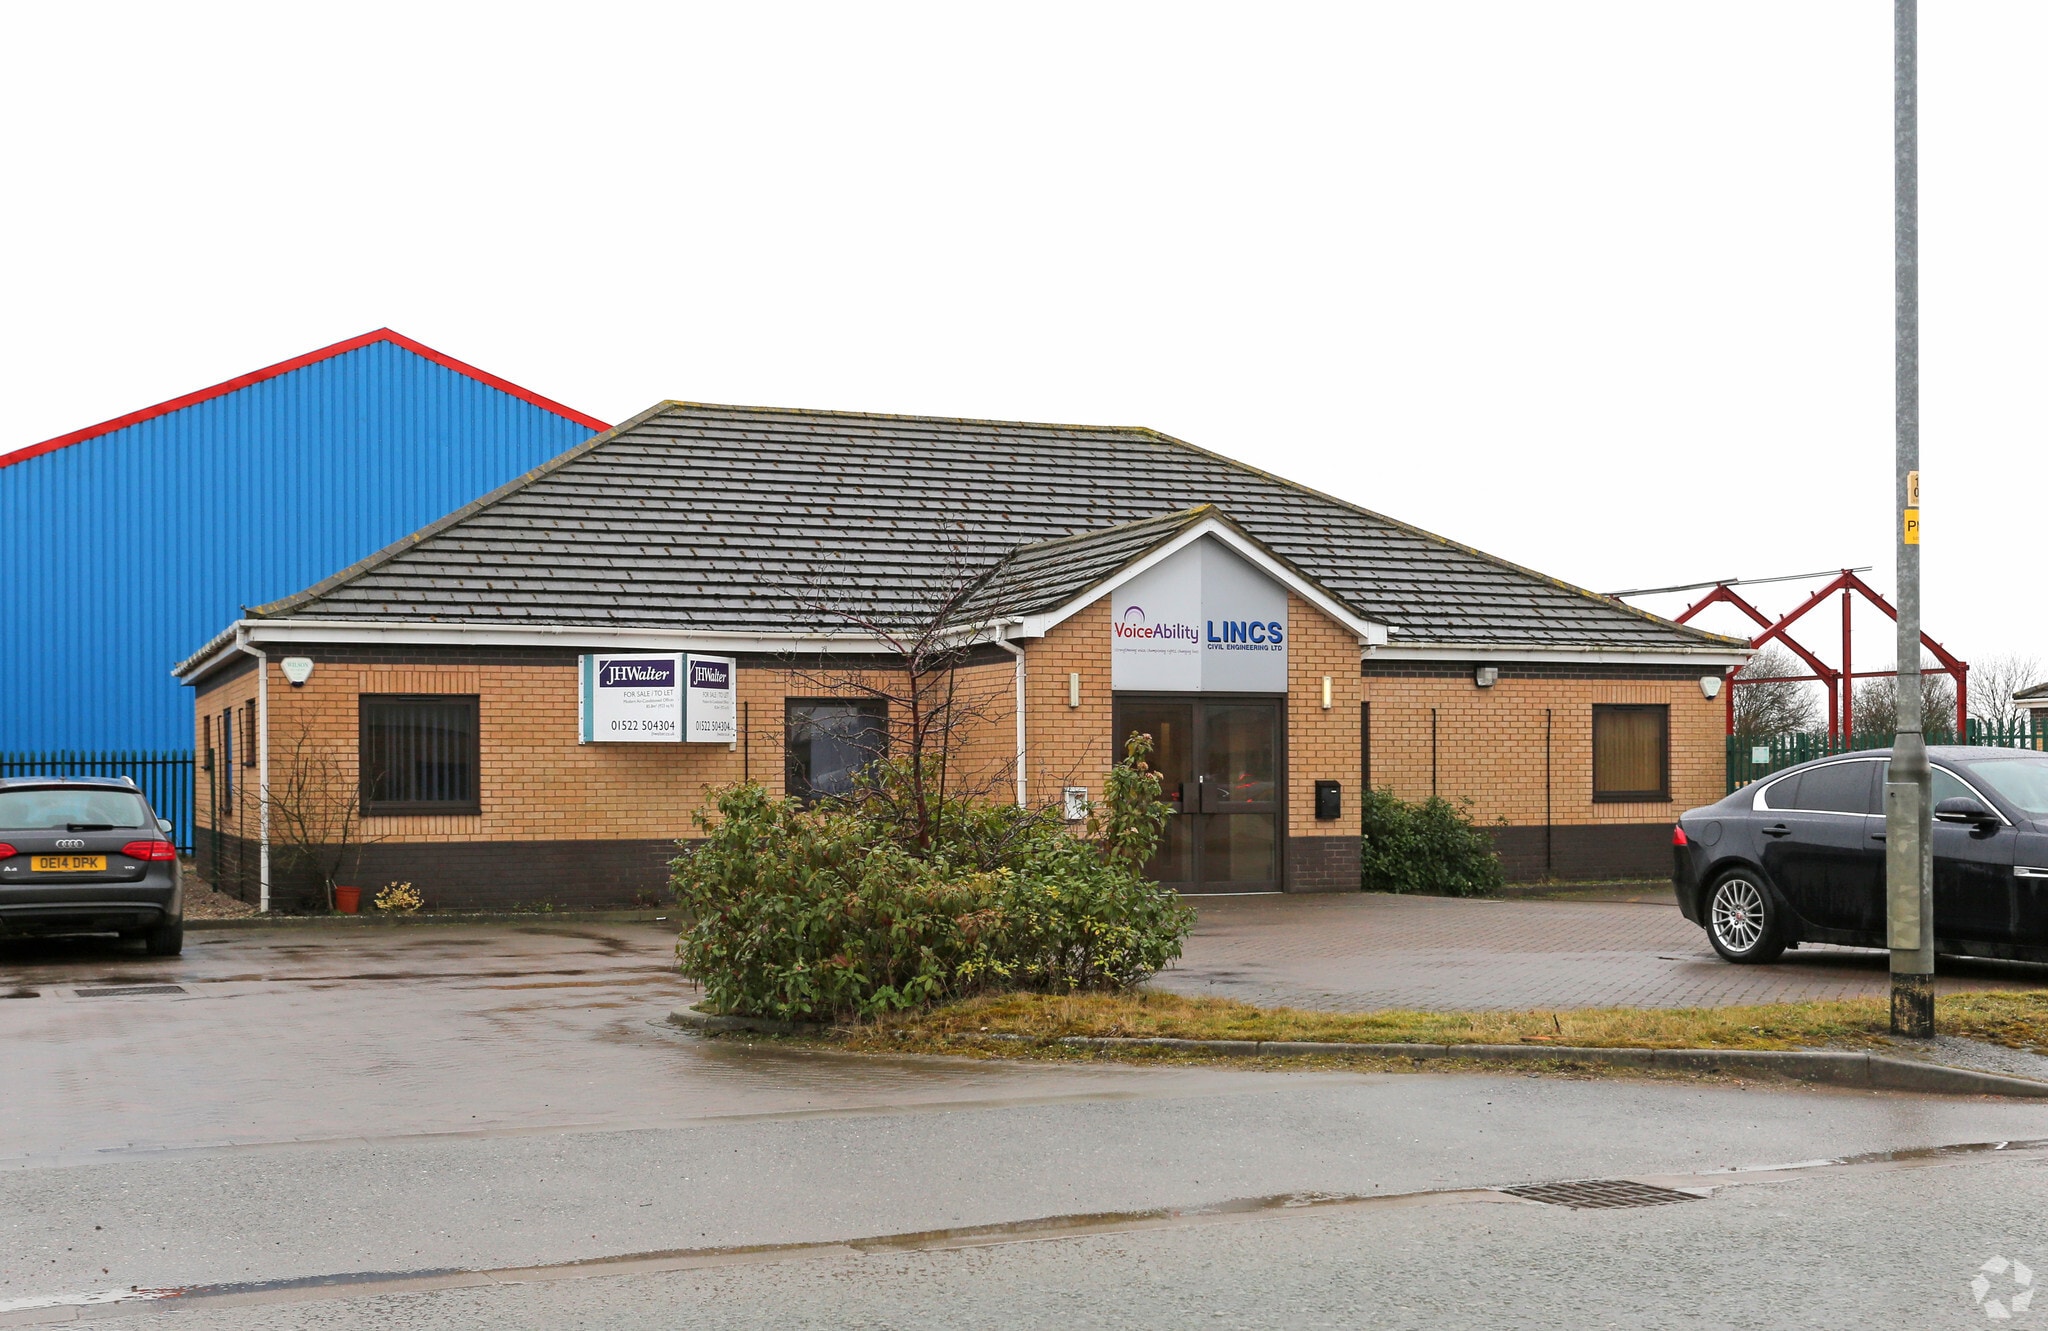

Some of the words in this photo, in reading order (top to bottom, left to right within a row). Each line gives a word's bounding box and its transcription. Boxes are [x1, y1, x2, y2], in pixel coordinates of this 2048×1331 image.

[1114, 622, 1199, 644] VoiceAbility
[1207, 620, 1283, 644] LINCS
[606, 666, 670, 685] JHWalter
[612, 720, 638, 730] 01522
[642, 720, 675, 730] 504304
[696, 721, 710, 730] 01522
[712, 721, 730, 731] 504304
[40, 858, 69, 868] OE14
[73, 857, 98, 868] DPK
